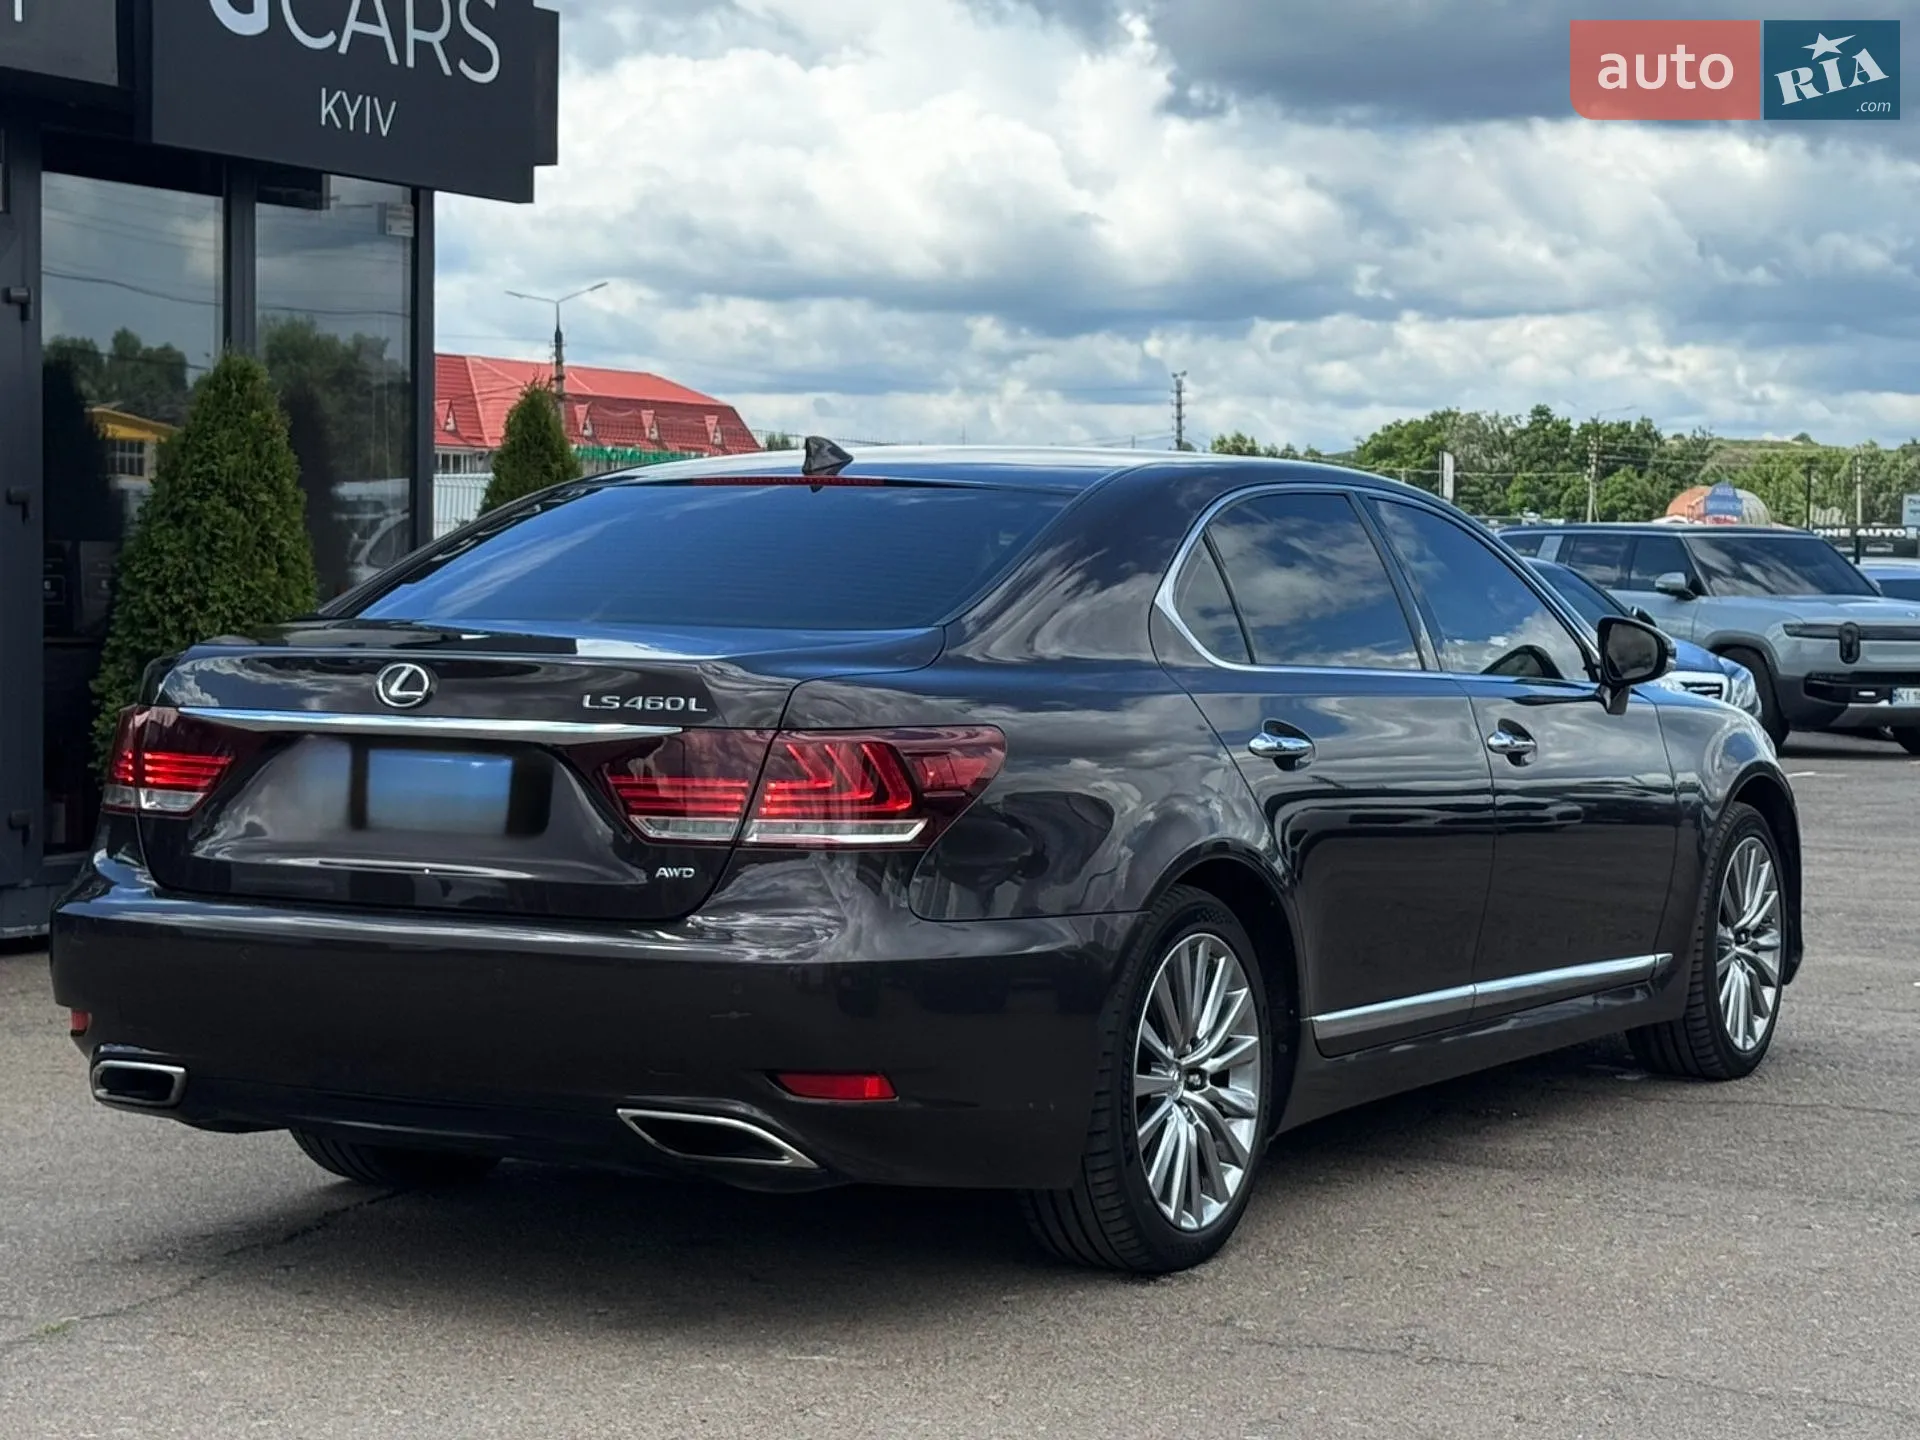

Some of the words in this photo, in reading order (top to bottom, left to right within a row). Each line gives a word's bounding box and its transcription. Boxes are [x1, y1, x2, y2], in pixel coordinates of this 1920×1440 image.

[320, 87, 397, 137] KYIV
[1856, 527, 1906, 538] AUTO
[655, 866, 696, 878] AWD
